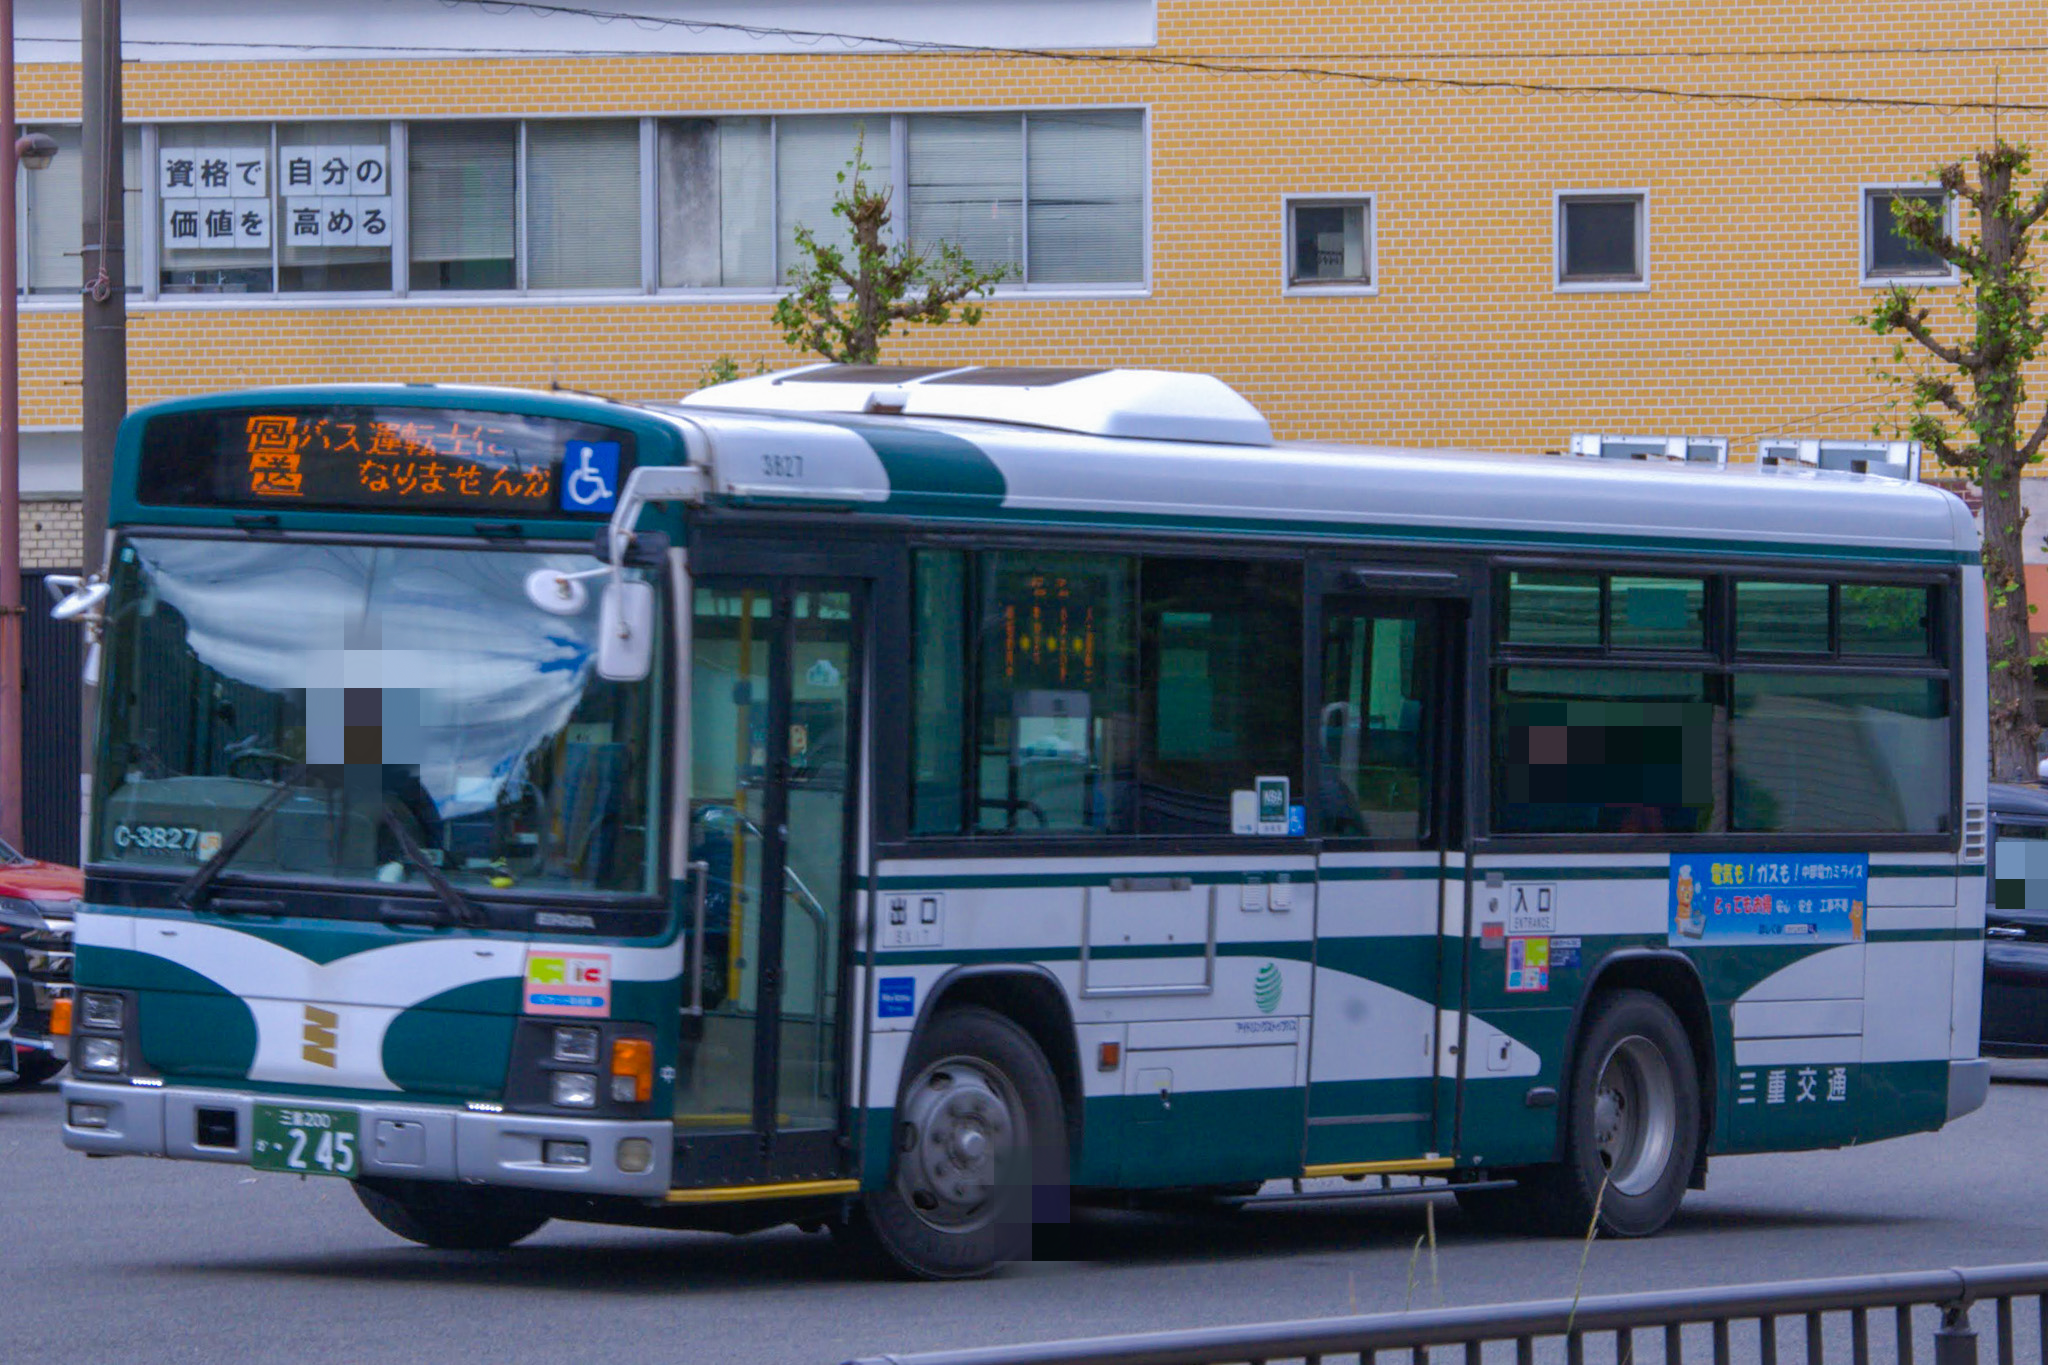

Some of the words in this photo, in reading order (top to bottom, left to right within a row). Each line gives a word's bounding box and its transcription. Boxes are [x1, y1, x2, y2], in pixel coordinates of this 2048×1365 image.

[166, 159, 262, 188] 資格で
[288, 157, 383, 186] 自分の
[170, 209, 263, 239] 価値を
[293, 208, 387, 236] 高める
[762, 454, 803, 477] 3827
[114, 825, 199, 850] C-3827
[890, 897, 937, 926] 出口
[1514, 887, 1551, 913] 入口
[1514, 916, 1551, 930] ENTRANCE
[1737, 1066, 1847, 1104] 三重交通
